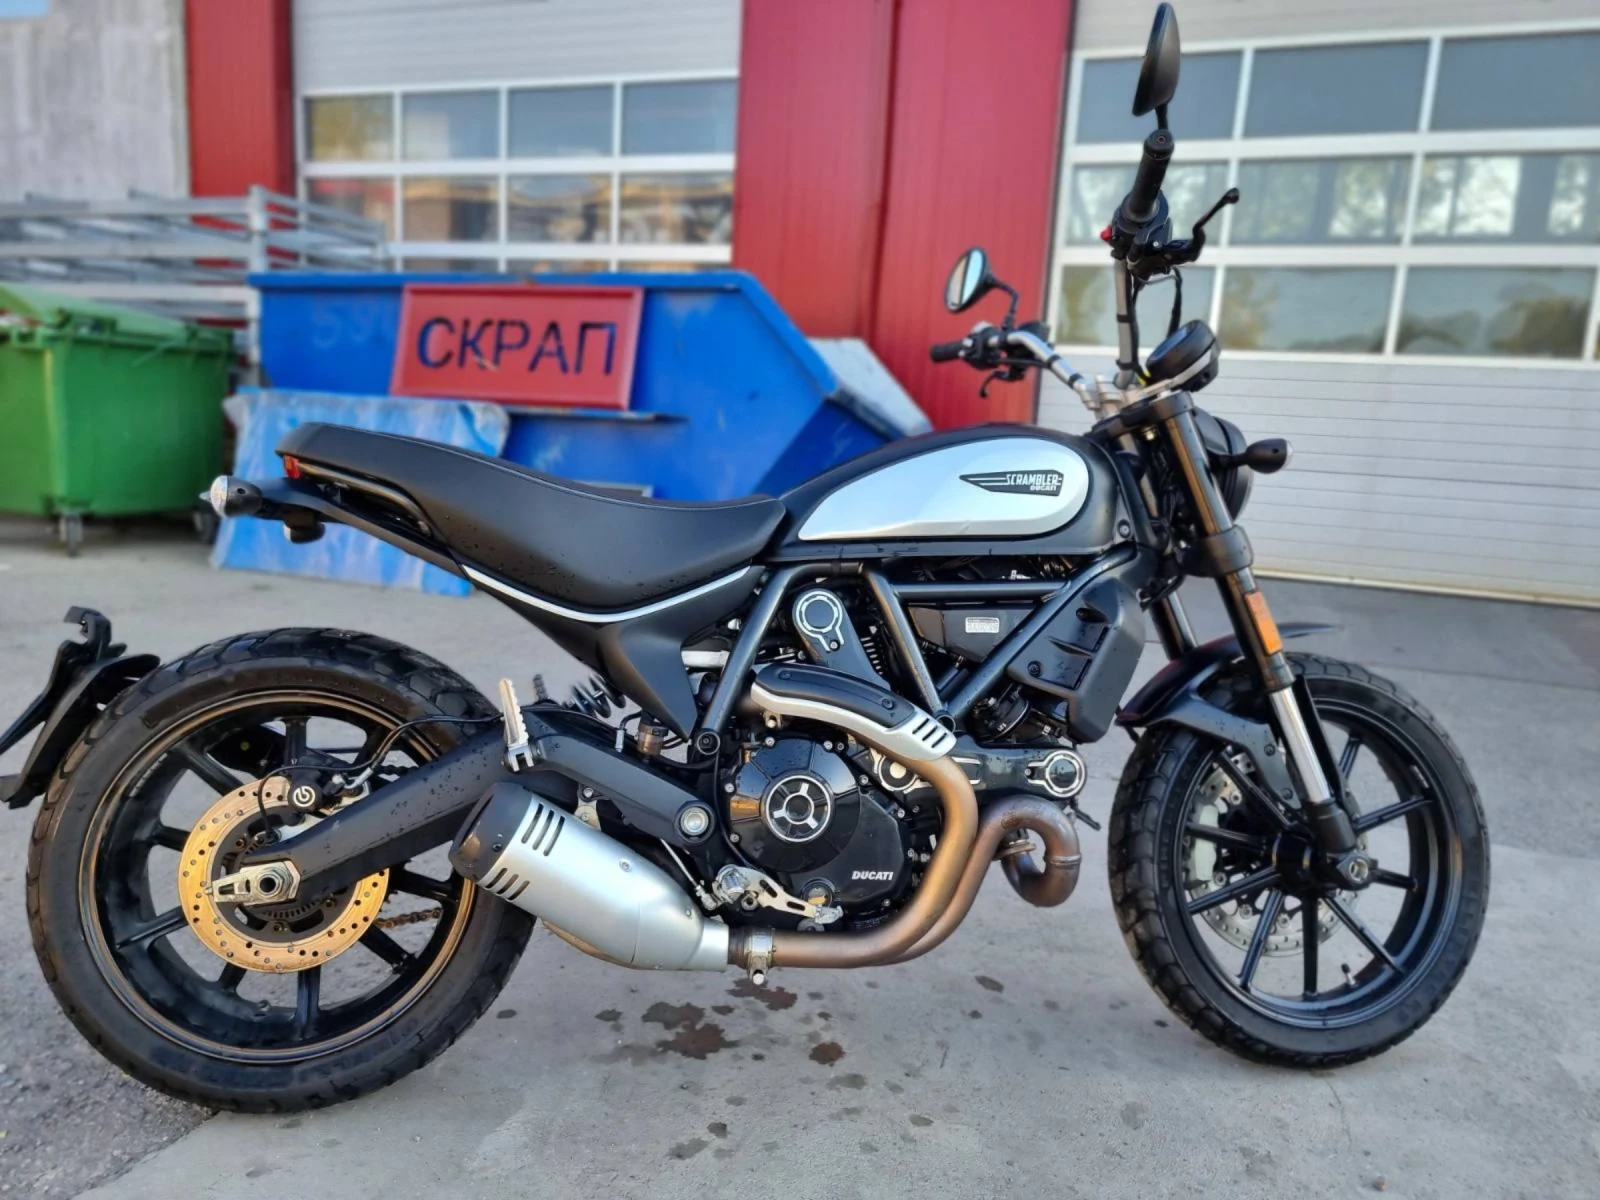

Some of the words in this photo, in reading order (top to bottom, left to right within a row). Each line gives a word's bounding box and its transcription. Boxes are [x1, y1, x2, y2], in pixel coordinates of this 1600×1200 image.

[417, 316, 617, 376] СКРАП
[1005, 473, 1060, 486] SCRAMBLER
[851, 870, 894, 880] DUCATI
